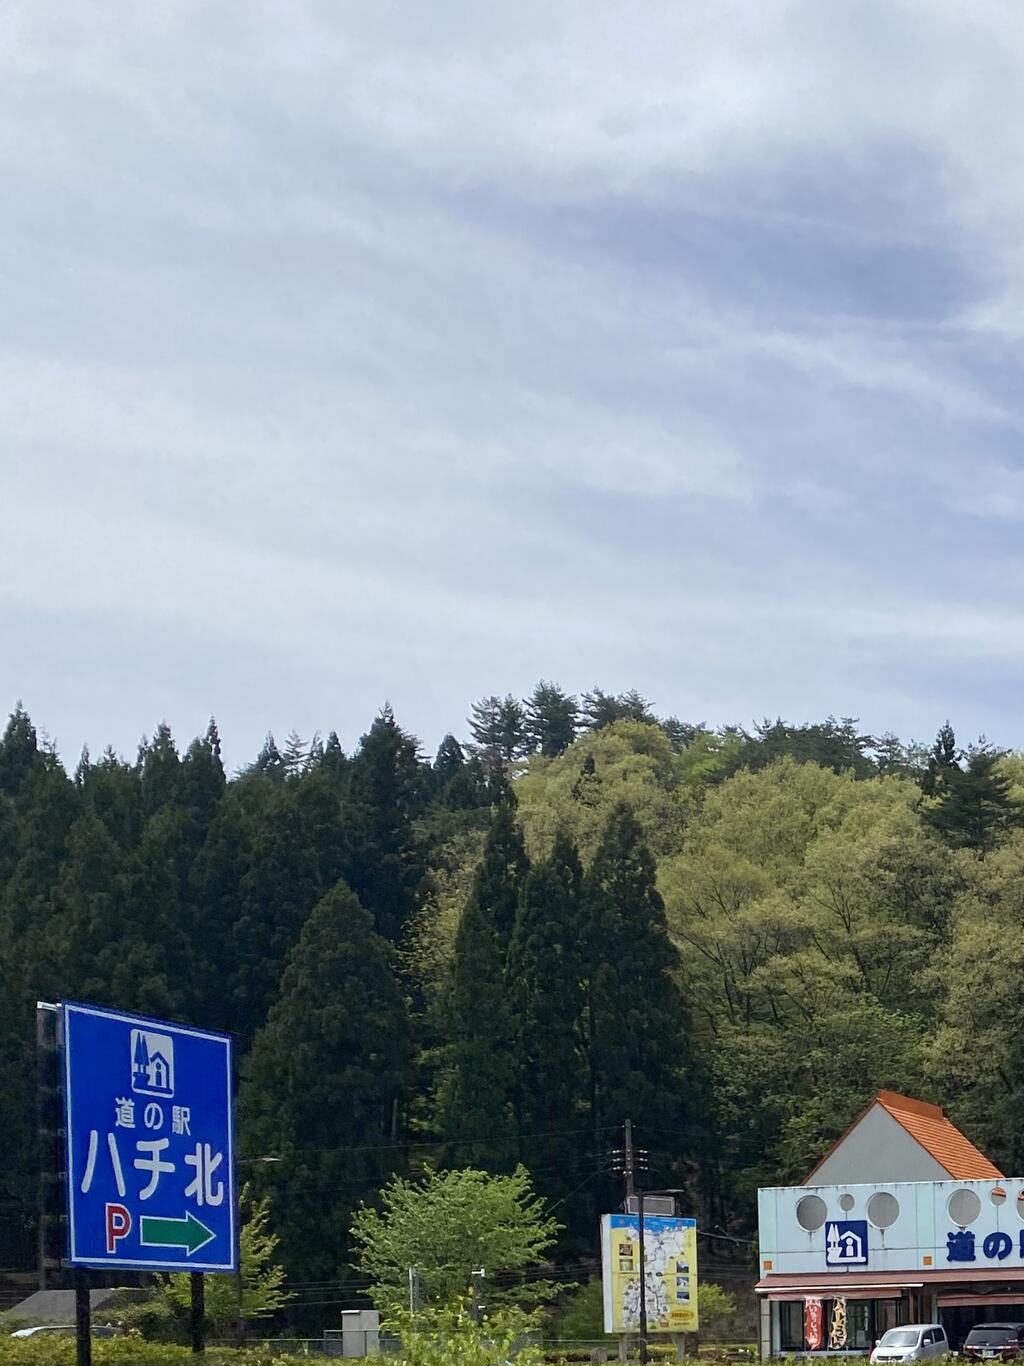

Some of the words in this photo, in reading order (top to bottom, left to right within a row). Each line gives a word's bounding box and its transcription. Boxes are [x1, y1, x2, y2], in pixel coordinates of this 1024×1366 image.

[115, 1097, 191, 1136] 道の駅
[81, 1130, 224, 1206] ハチ北
[105, 1203, 132, 1254] P
